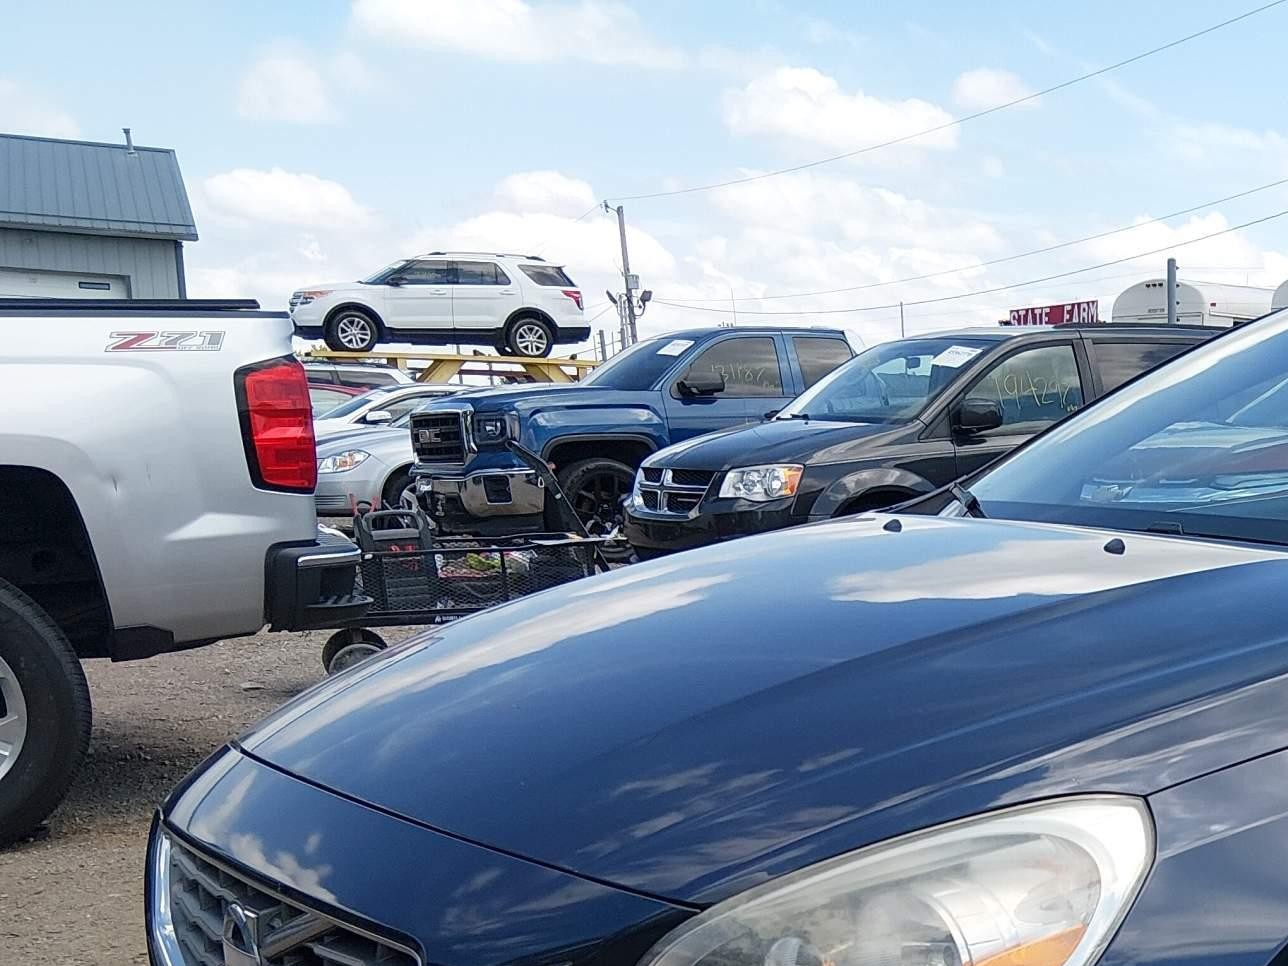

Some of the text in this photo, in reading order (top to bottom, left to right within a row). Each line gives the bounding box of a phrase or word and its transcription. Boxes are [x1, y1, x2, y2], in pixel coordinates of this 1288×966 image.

[1010, 301, 1098, 327] STATE FARM
[104, 331, 226, 352] Z71
